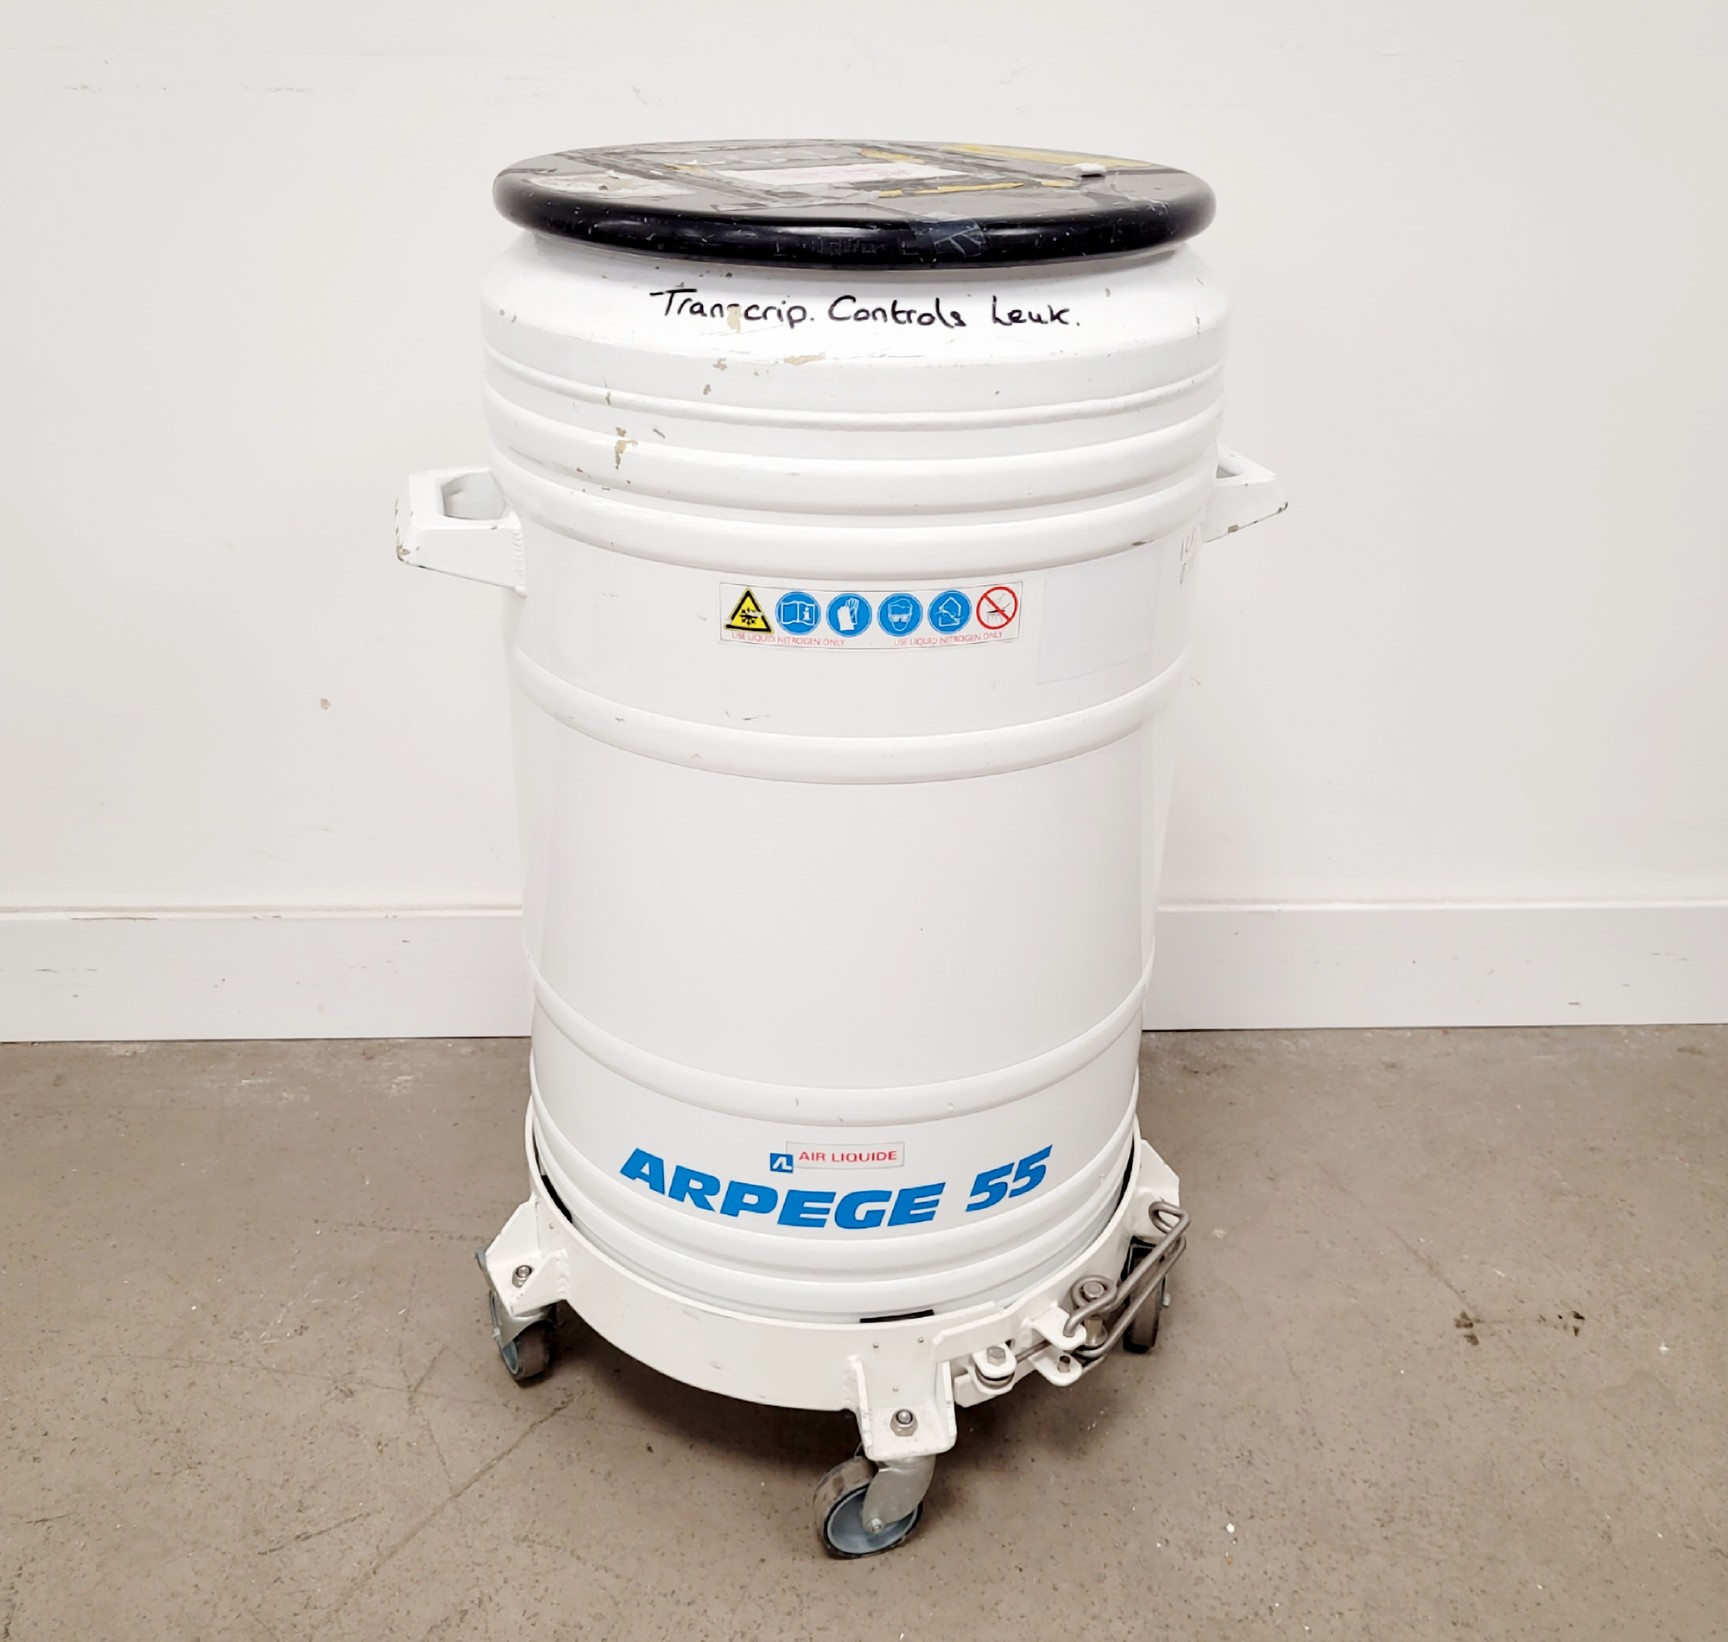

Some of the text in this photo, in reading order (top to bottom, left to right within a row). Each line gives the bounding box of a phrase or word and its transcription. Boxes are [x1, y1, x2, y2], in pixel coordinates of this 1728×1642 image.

[828, 295, 967, 328] Controls
[731, 631, 845, 647] USE LIQUID NITROGEN ONLY
[894, 631, 1003, 646] USE LIQUID NITROGEN ONLY
[799, 1151, 826, 1161] AIR
[831, 1150, 898, 1163] LIQUIDE
[620, 1144, 1053, 1229] ARPEGE 55
